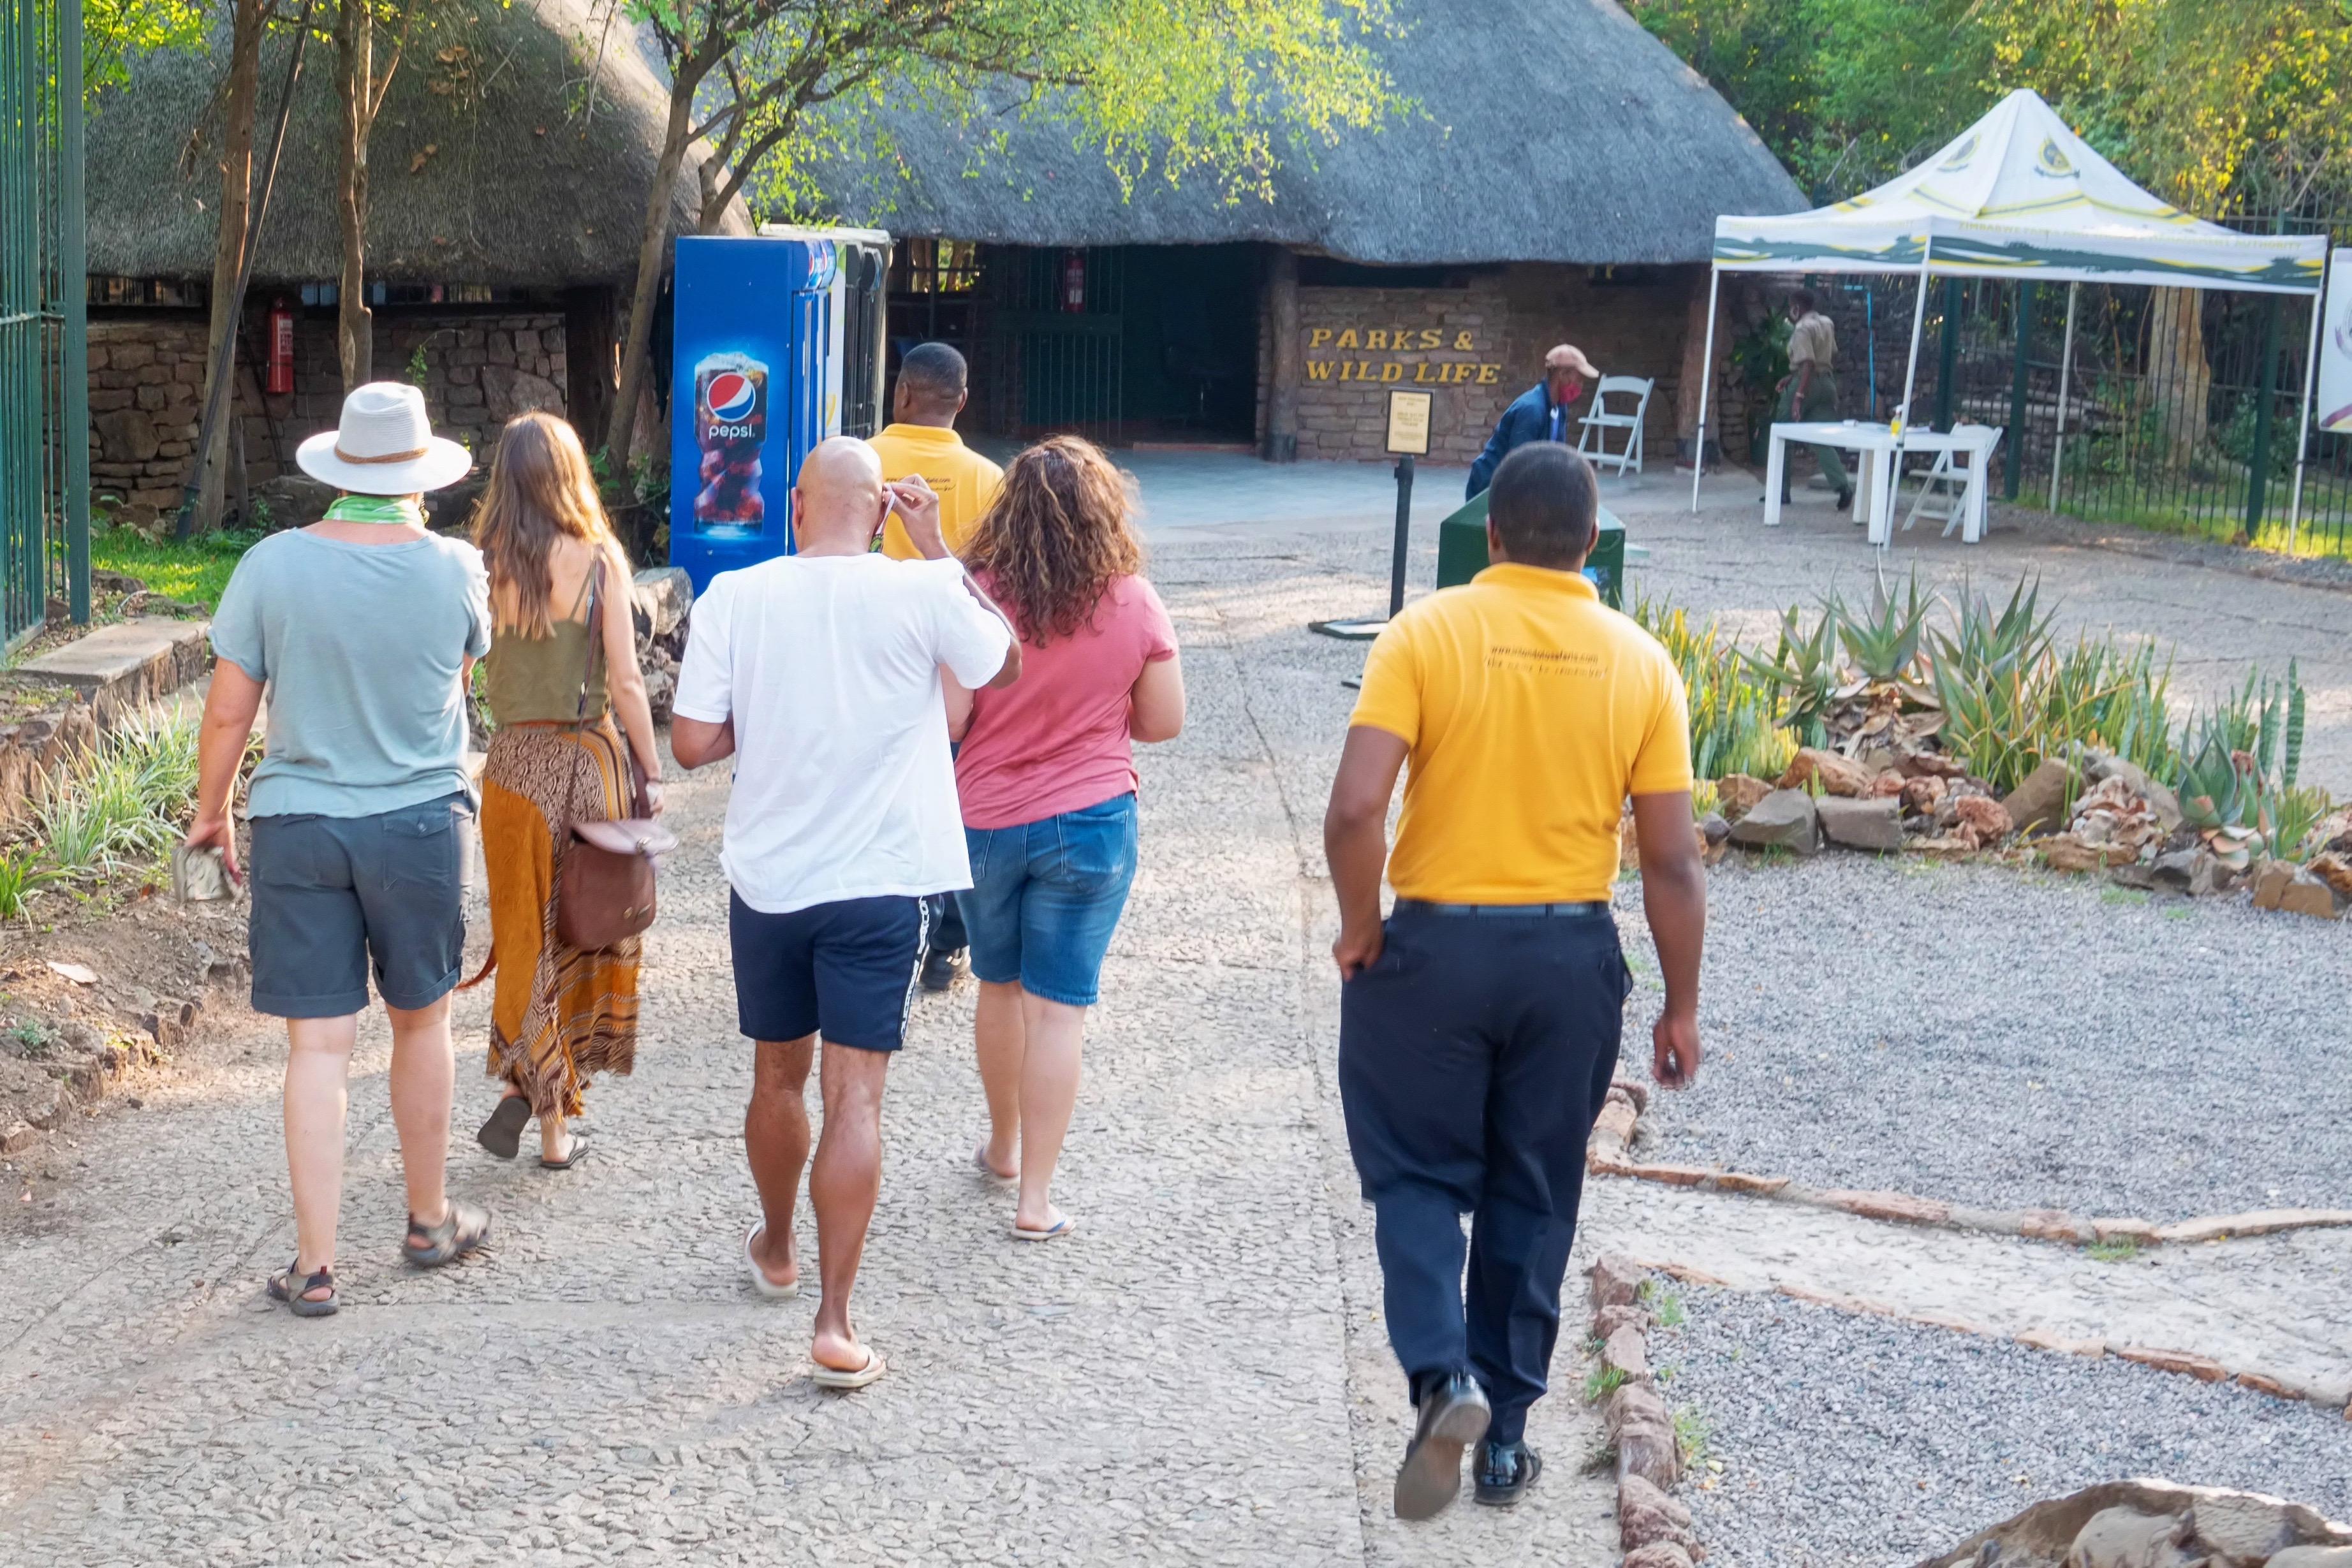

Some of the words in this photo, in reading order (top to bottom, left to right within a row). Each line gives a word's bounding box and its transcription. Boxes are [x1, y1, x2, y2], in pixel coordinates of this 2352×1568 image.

[1309, 328, 1443, 350] PARKS
[1453, 330, 1474, 351] &
[709, 423, 752, 440] pepsi
